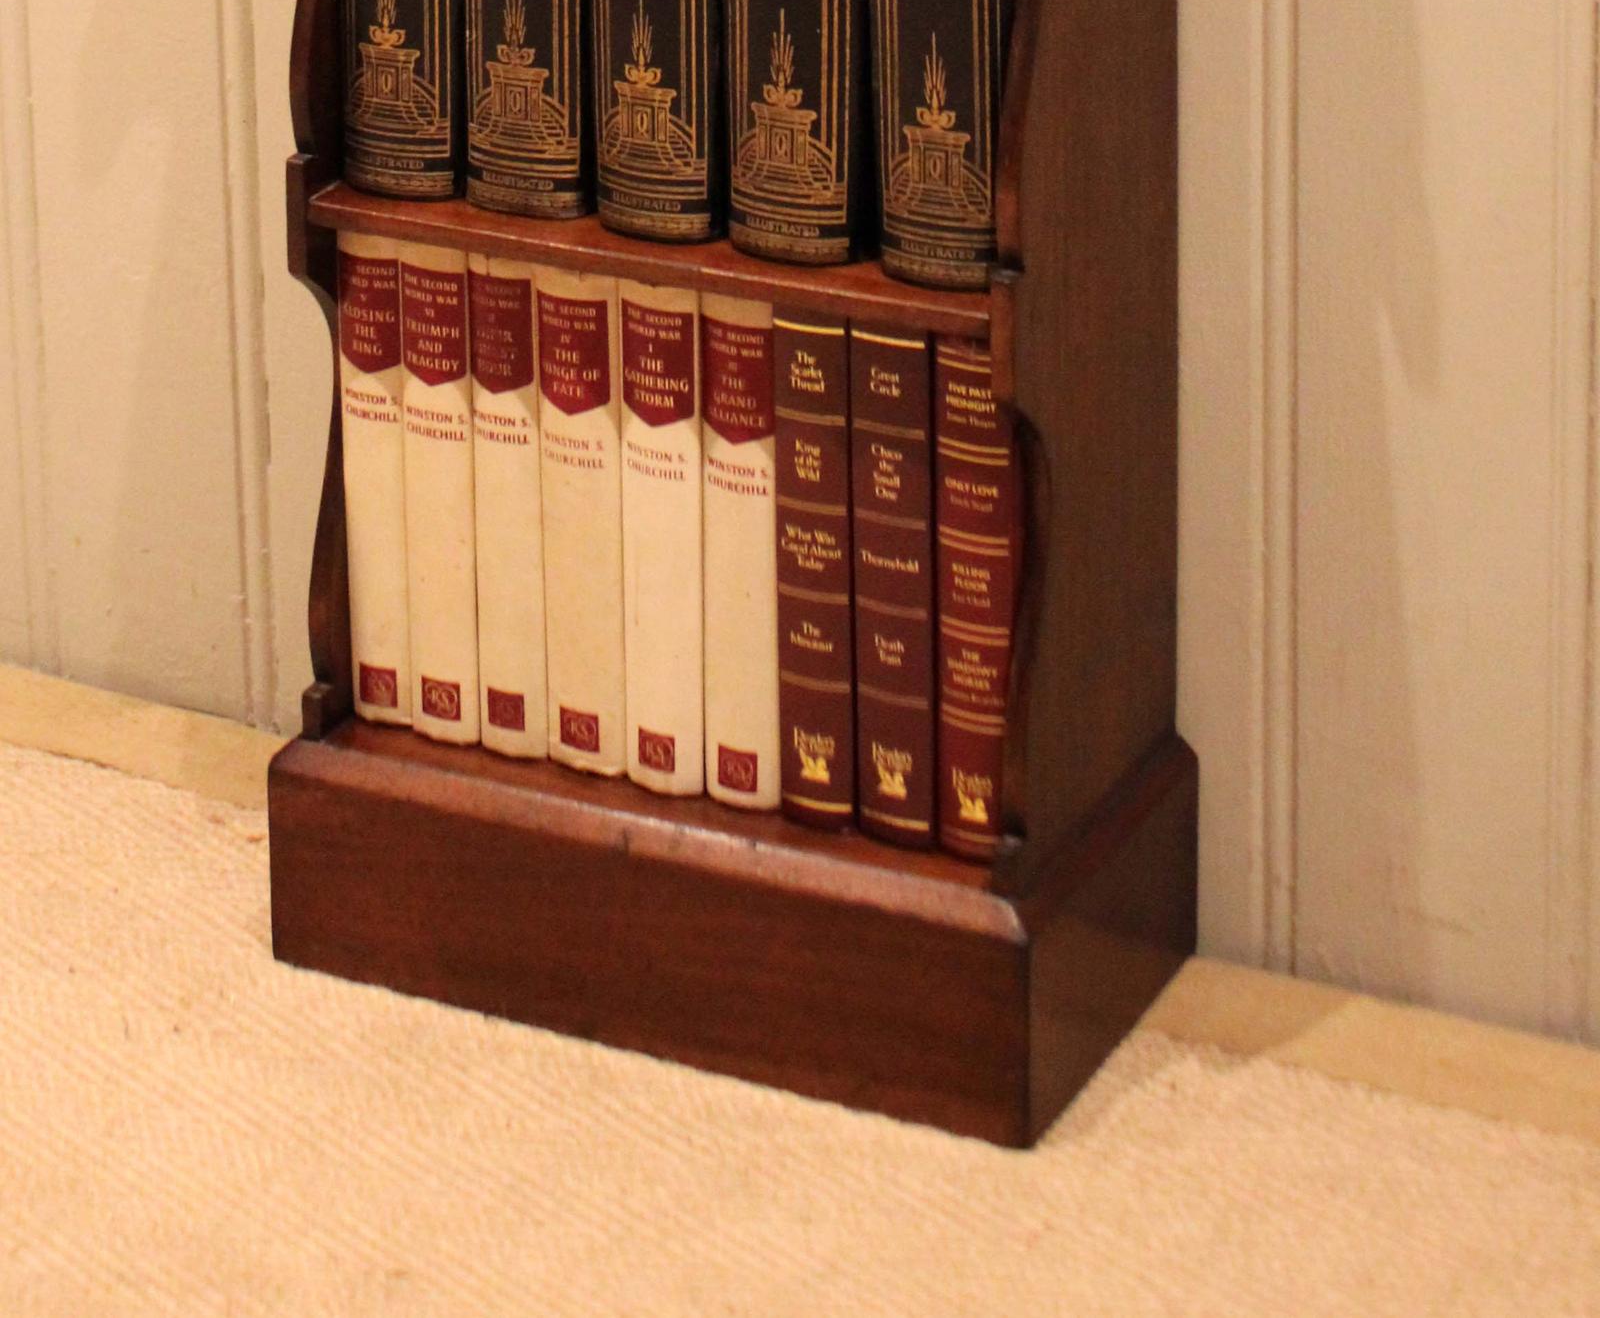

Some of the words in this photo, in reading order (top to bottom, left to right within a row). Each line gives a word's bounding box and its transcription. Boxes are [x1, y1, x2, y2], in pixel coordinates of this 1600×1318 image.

[482, 170, 555, 191] ILLUSTRATED
[612, 190, 682, 212] ILLUSTRATED
[746, 215, 821, 238] ILLUSTRATED
[900, 239, 976, 260] ILLUSTRATED
[356, 264, 396, 277] SECOND
[373, 280, 397, 290] WAR
[403, 272, 418, 286] THE
[421, 277, 458, 293] SECOND
[404, 287, 433, 304] WORLD
[436, 295, 459, 306] WAR
[342, 302, 396, 324] CLOSING
[541, 300, 554, 312] THE
[559, 304, 597, 318] SECOND
[627, 306, 641, 321] THE
[645, 313, 683, 327] SECOND
[354, 324, 377, 339] THE
[405, 317, 460, 339] TRIUMPH
[542, 315, 571, 330] WORLD
[573, 320, 597, 332] WAR
[627, 321, 656, 336] WORLD
[658, 329, 682, 341] WAR
[417, 339, 443, 354] AND
[726, 331, 765, 345] SECOND
[554, 348, 580, 364] THE
[740, 345, 764, 358] WAR
[796, 349, 817, 366] The
[406, 350, 460, 373] TRAGEDY
[639, 357, 665, 372] THE
[582, 370, 600, 382] OF
[624, 367, 690, 394] GATHERING
[791, 363, 823, 380] Scarlet
[870, 366, 900, 384] Great
[552, 383, 585, 399] FATE
[721, 375, 746, 391] THE
[790, 376, 825, 394] Thread
[869, 381, 901, 398] Circle
[345, 387, 387, 406] WINSTON
[634, 389, 675, 409] STORM
[713, 392, 757, 410] GRAND
[968, 386, 993, 401] PAST
[945, 394, 997, 414] MIDNIGHT
[345, 403, 400, 424] CHURCHILL
[405, 405, 451, 424] WINSTON
[406, 422, 467, 443] CHURCHILL
[543, 431, 590, 451] WINSTON
[626, 441, 673, 463] WINSTON
[795, 438, 821, 458] King
[543, 448, 605, 469] CHURCHILL
[708, 455, 756, 479] WINSTON
[805, 455, 821, 467] the
[879, 459, 895, 474] the
[626, 458, 687, 481] CHURCHILL
[795, 466, 820, 482] Wild
[707, 474, 770, 497] CHURCHILL
[873, 470, 901, 489] Small
[875, 486, 899, 501] One
[972, 483, 999, 499] LOVE
[785, 523, 812, 542] What
[808, 544, 842, 560] About
[802, 621, 821, 639] The
[874, 633, 905, 654] Death
[961, 647, 981, 663] THE
